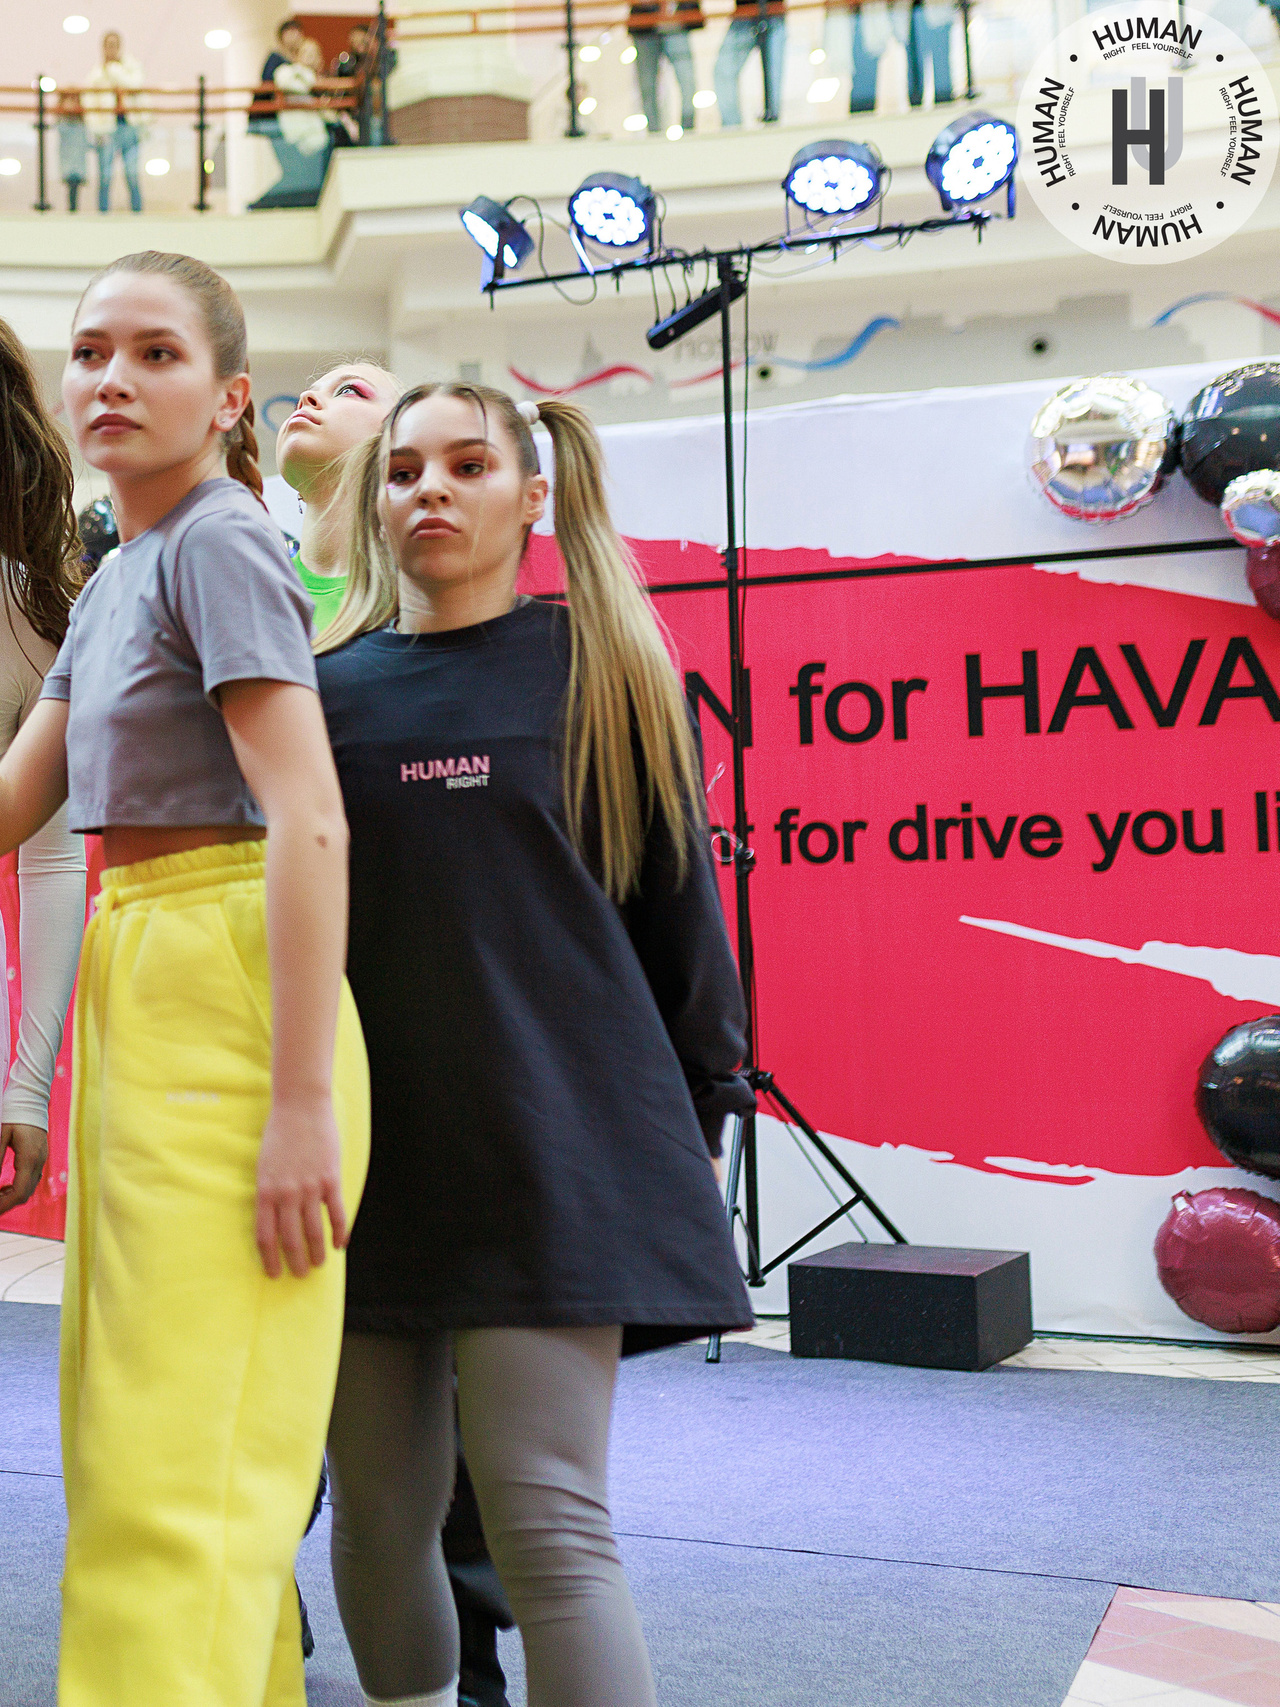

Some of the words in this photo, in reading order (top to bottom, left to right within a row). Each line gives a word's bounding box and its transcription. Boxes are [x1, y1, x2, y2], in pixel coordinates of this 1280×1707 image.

[788, 662, 929, 746] for
[965, 636, 1280, 738] HAVA
[401, 754, 490, 782] HUMAN
[446, 774, 490, 790] RIGHT
[774, 808, 869, 865] for
[888, 802, 1065, 862] drive
[1086, 807, 1225, 873] you
